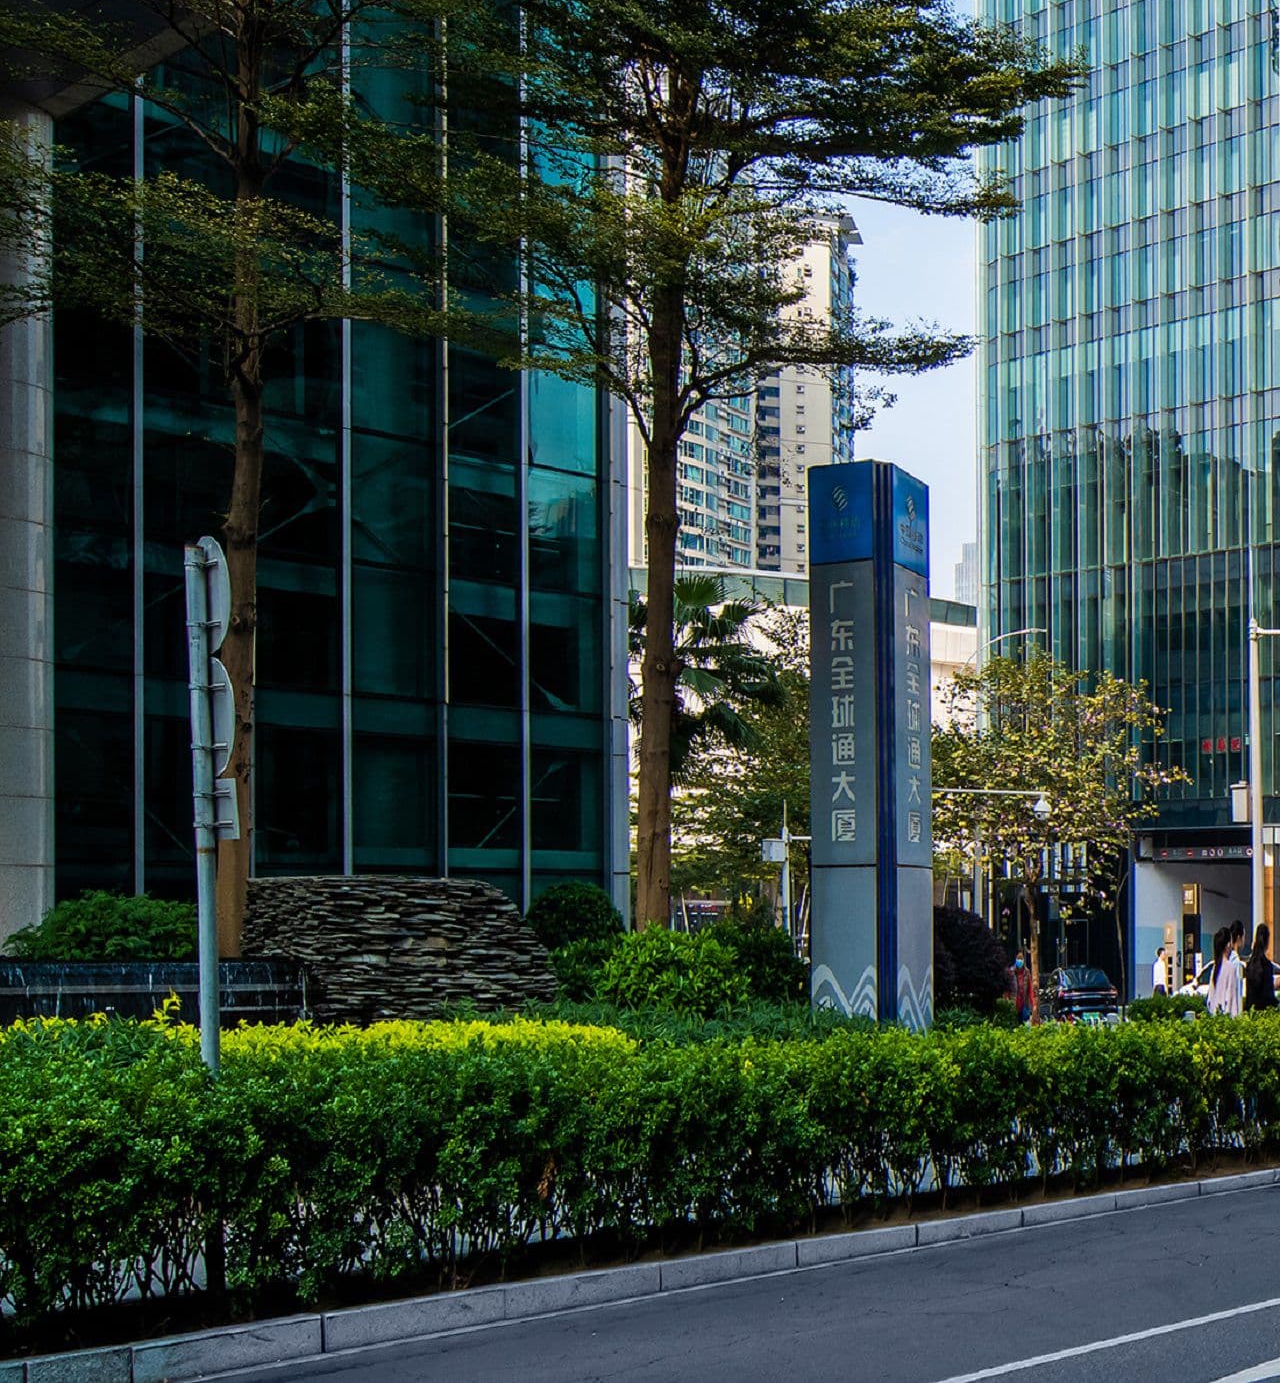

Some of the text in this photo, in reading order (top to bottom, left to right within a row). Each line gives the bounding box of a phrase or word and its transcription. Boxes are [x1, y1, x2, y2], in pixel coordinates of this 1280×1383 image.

[829, 580, 856, 842] 广东全球通大厦
[904, 588, 922, 843] 广东全球通大厦
